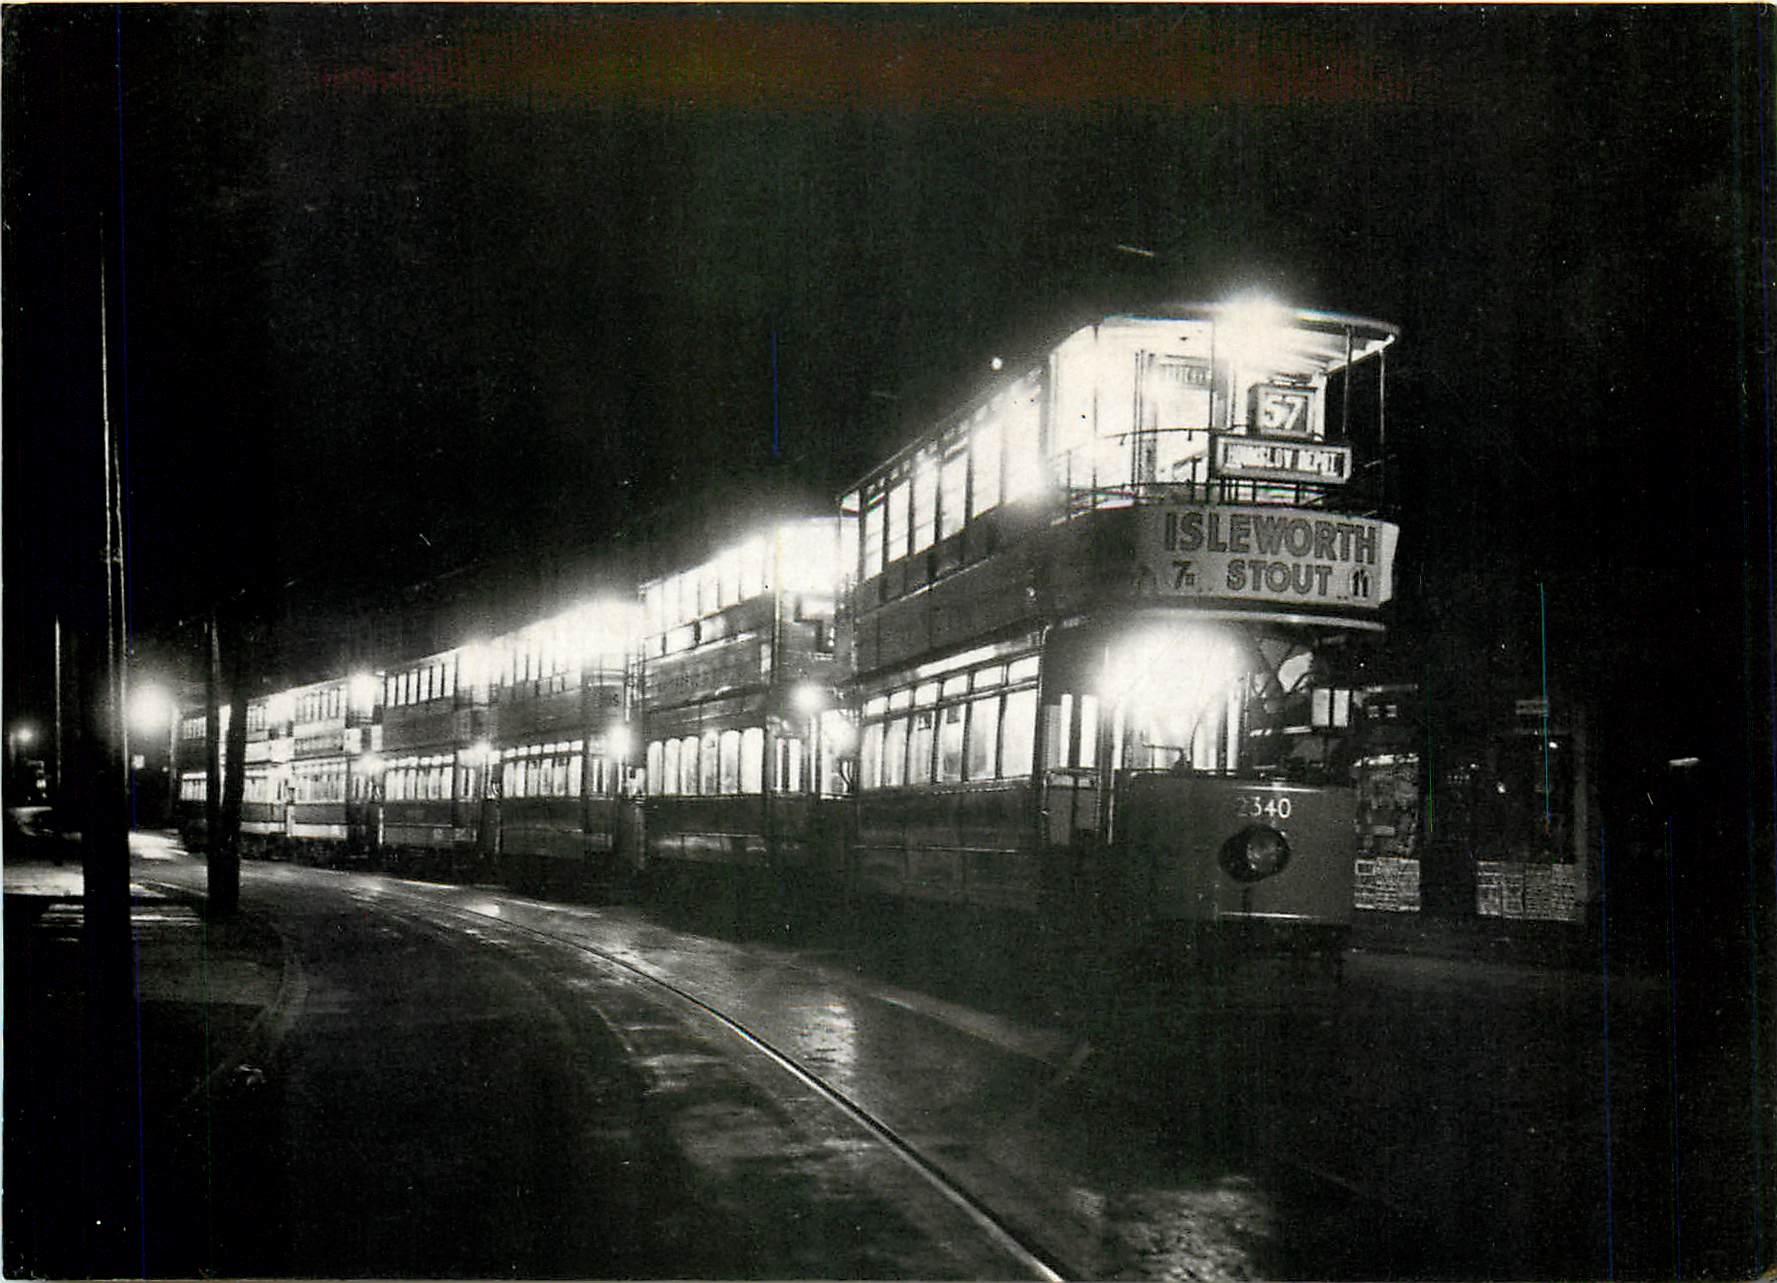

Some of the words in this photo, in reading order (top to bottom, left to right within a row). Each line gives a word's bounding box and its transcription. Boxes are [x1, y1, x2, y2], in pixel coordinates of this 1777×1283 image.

[1264, 395, 1303, 429] 57
[1165, 511, 1376, 564] ISLEWORTH
[1226, 559, 1332, 596] STOUT
